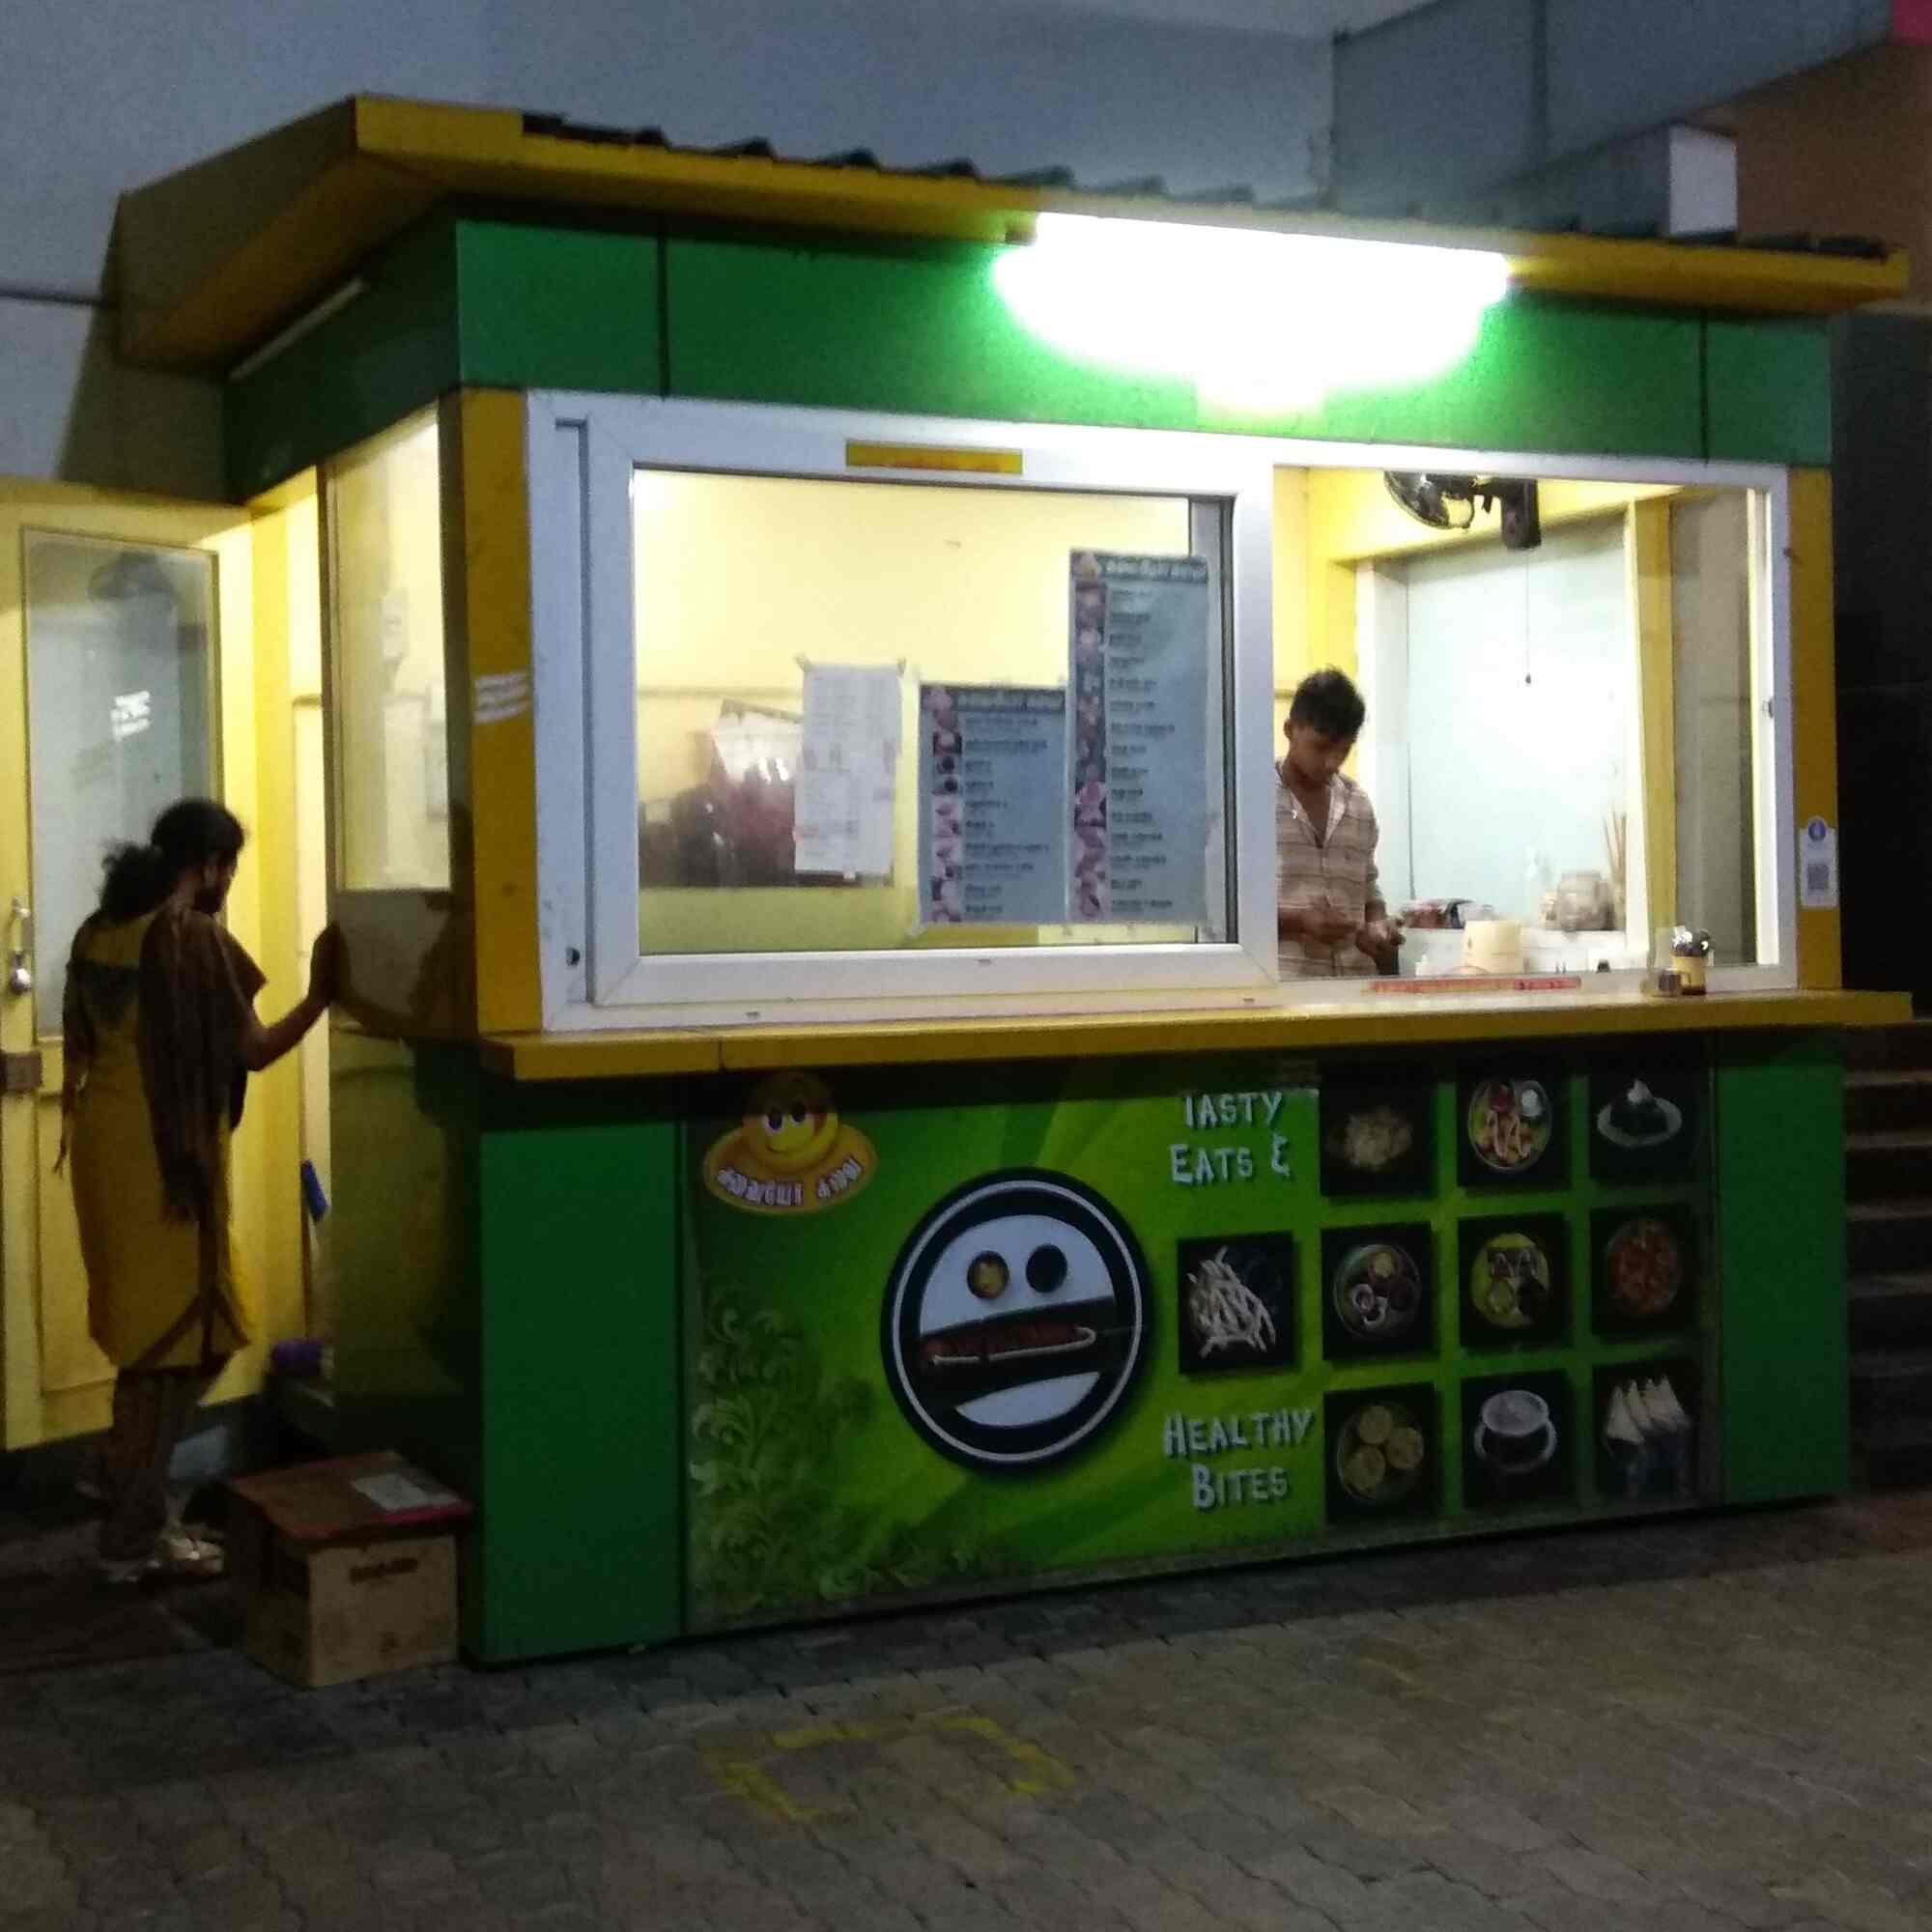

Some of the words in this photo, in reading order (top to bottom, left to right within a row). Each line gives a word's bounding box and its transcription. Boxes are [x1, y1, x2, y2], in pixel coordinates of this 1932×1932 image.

[1170, 1143, 1254, 1183] EATS
[1164, 1406, 1313, 1456] HEALTHY
[1192, 1463, 1290, 1509] BITES
